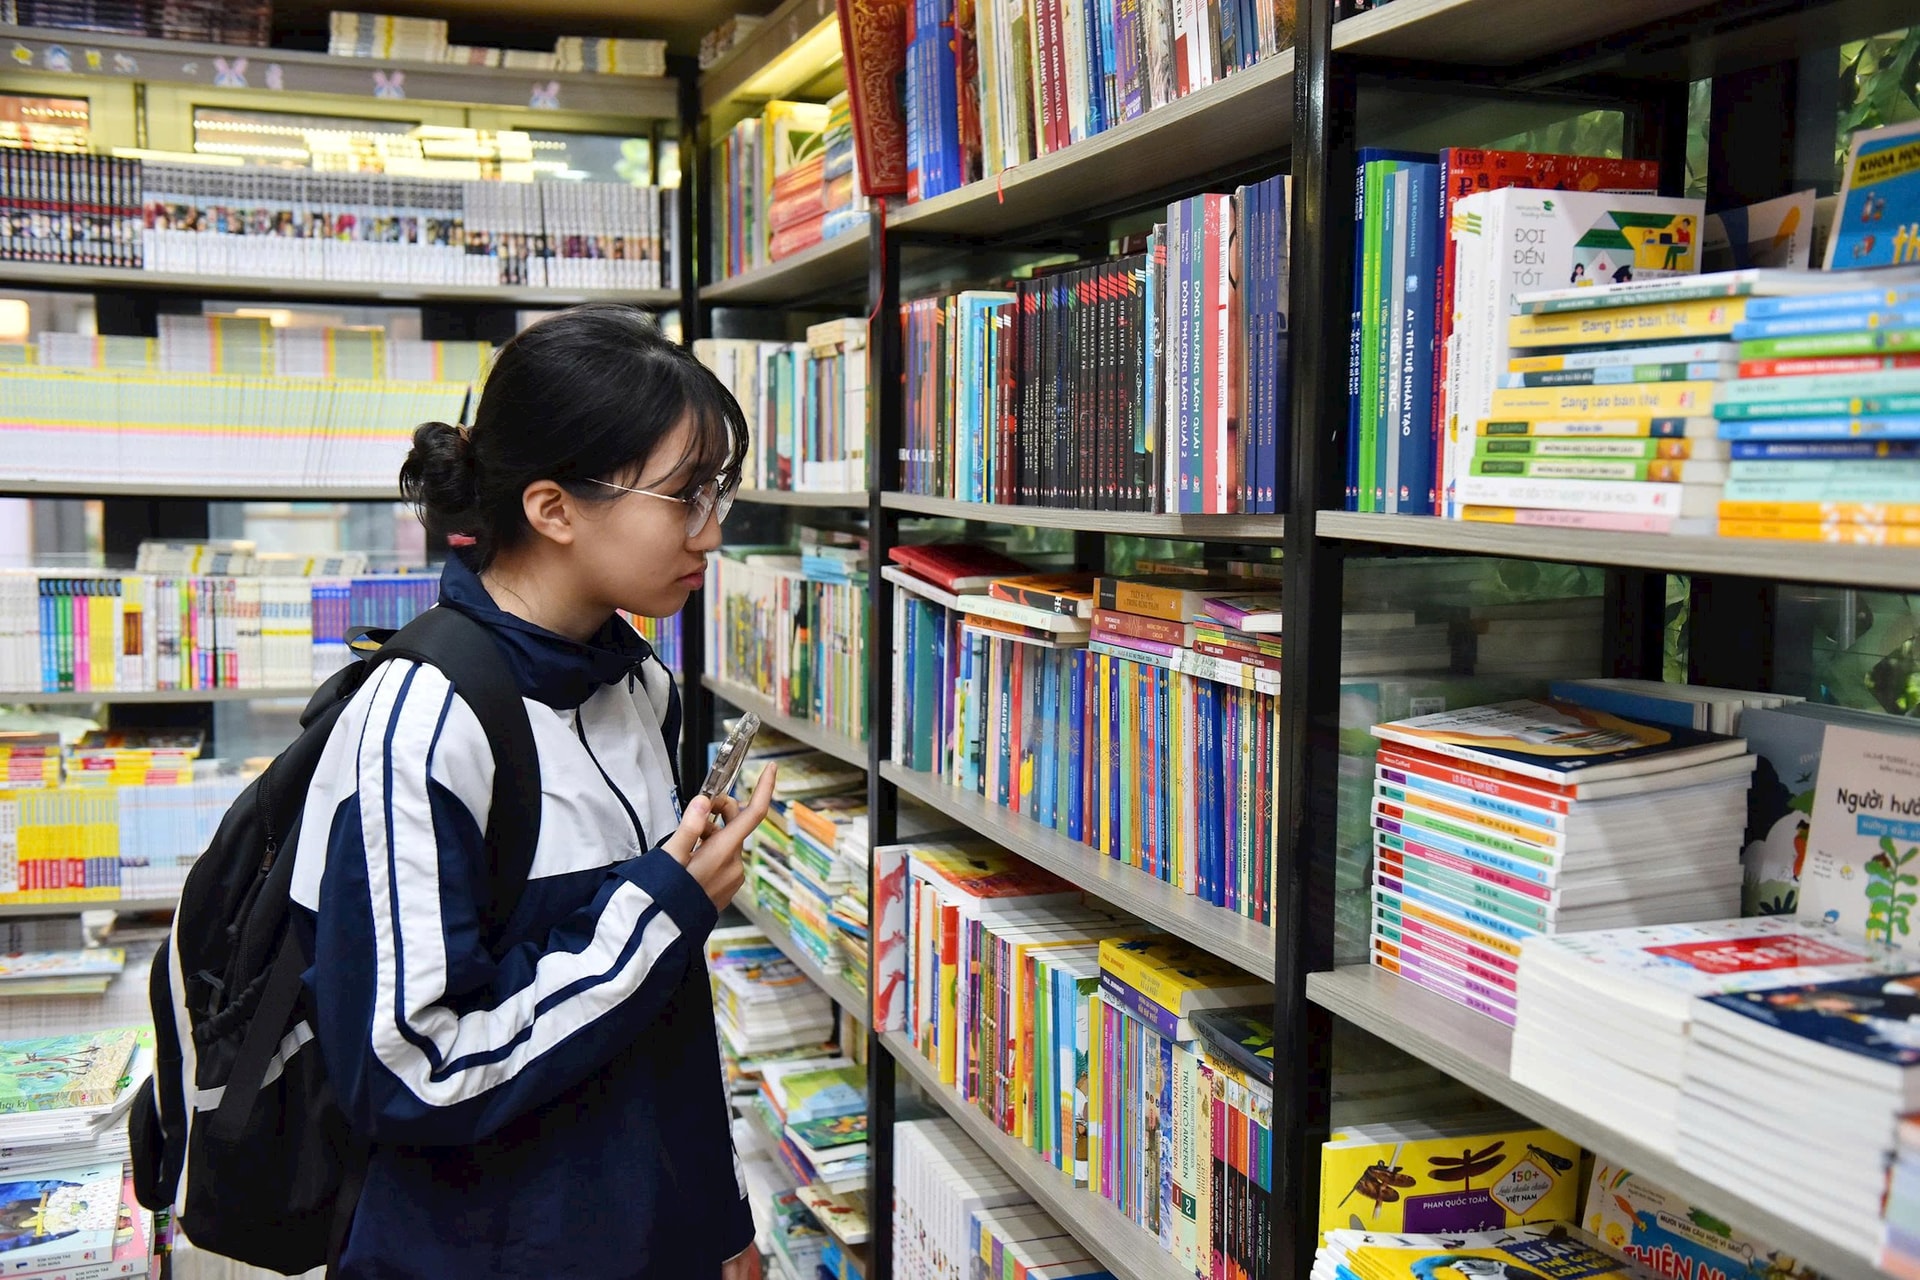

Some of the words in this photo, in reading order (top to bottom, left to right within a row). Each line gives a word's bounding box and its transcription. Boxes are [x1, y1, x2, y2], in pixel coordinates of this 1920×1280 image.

[1037, 19, 1045, 48] LONG
[1050, 13, 1058, 43] LONG
[1039, 50, 1047, 84] GIANG
[1052, 45, 1060, 79] GIANG
[1439, 162, 1447, 190] MARIA
[1410, 180, 1418, 203] LASSE
[1515, 228, 1546, 245] ĐỢI
[1406, 309, 1415, 321] AI
[1181, 321, 1189, 372] PHƯƠNG
[1193, 321, 1201, 374] PHƯƠNG
[1390, 328, 1401, 364] KIẾN
[1405, 330, 1415, 350] TRÍ
[1403, 350, 1414, 373] TUỆ
[1181, 376, 1189, 410] BÁCH
[1193, 378, 1201, 412] BÁCH
[1389, 368, 1401, 412] TRÚC
[1403, 375, 1414, 412] NHÂN
[1181, 414, 1189, 446] QUÁI
[1193, 416, 1201, 449] QUÁI
[1401, 414, 1411, 436] TẠO
[1181, 450, 1189, 458] 2
[1837, 787, 1884, 814] Người
[1512, 1170, 1539, 1183] 150+
[1186, 1198, 1192, 1215] 2
[1423, 1201, 1444, 1210] PHAN
[1445, 1196, 1467, 1208] QUỐC
[1506, 1194, 1521, 1204] VIỆT
[1521, 1193, 1538, 1201] NAM
[1727, 1243, 1741, 1254] SAO
